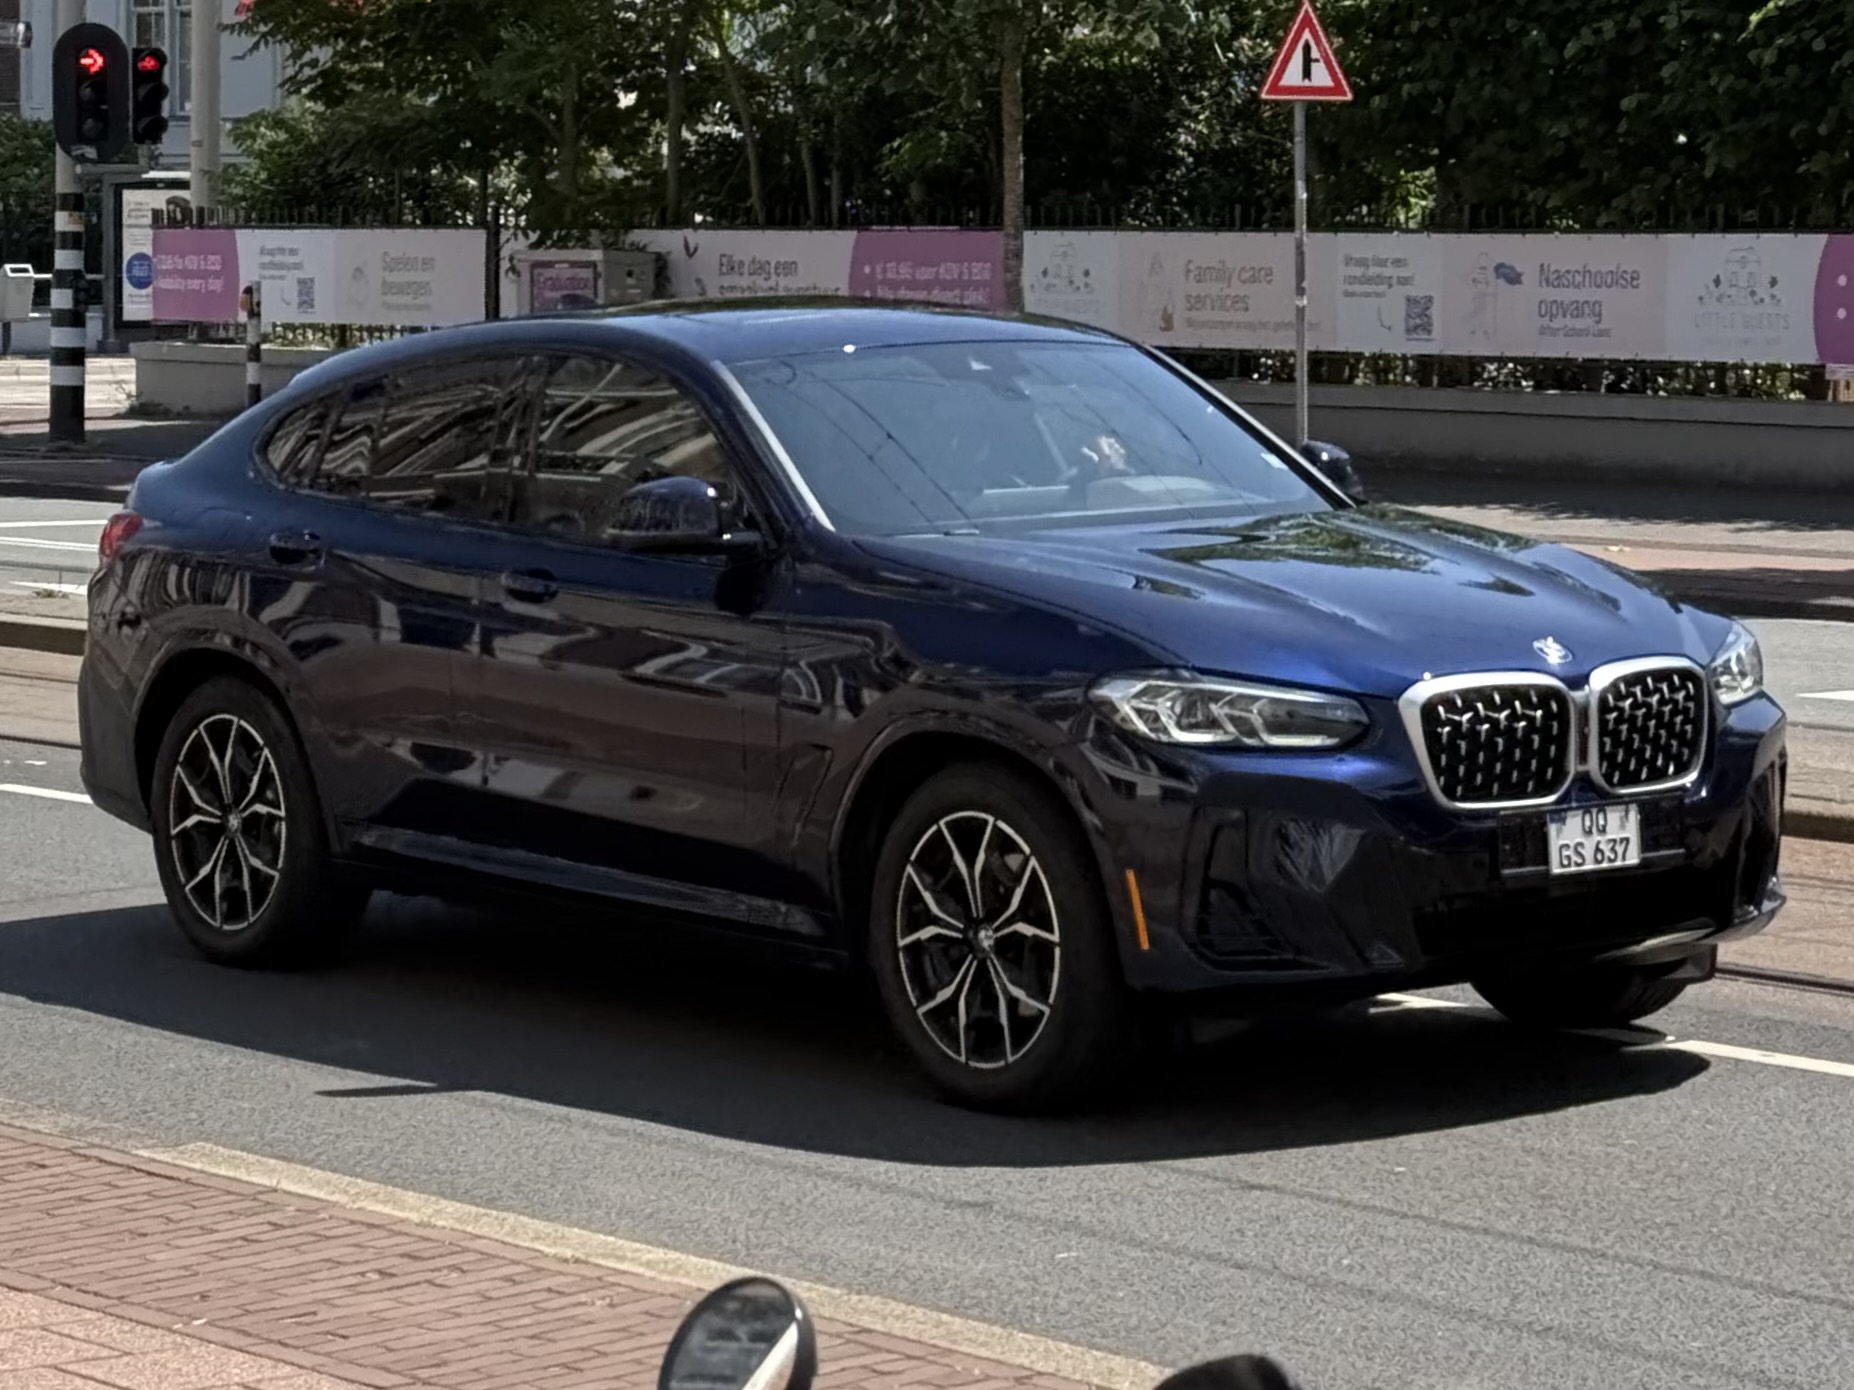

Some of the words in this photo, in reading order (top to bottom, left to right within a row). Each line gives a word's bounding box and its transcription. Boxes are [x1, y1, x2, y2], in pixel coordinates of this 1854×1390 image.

[382, 251, 418, 273] Spelen
[718, 253, 745, 277] Elke
[748, 255, 771, 281] dag
[774, 259, 799, 278] een
[1184, 259, 1232, 288] Family
[1237, 265, 1274, 285] care
[1538, 261, 1641, 290] Naschoolse
[1184, 289, 1251, 312] services
[1538, 299, 1603, 324] opvang
[1582, 806, 1607, 835] QQ
[1559, 841, 1586, 868] GS
[1594, 836, 1631, 864] 637
